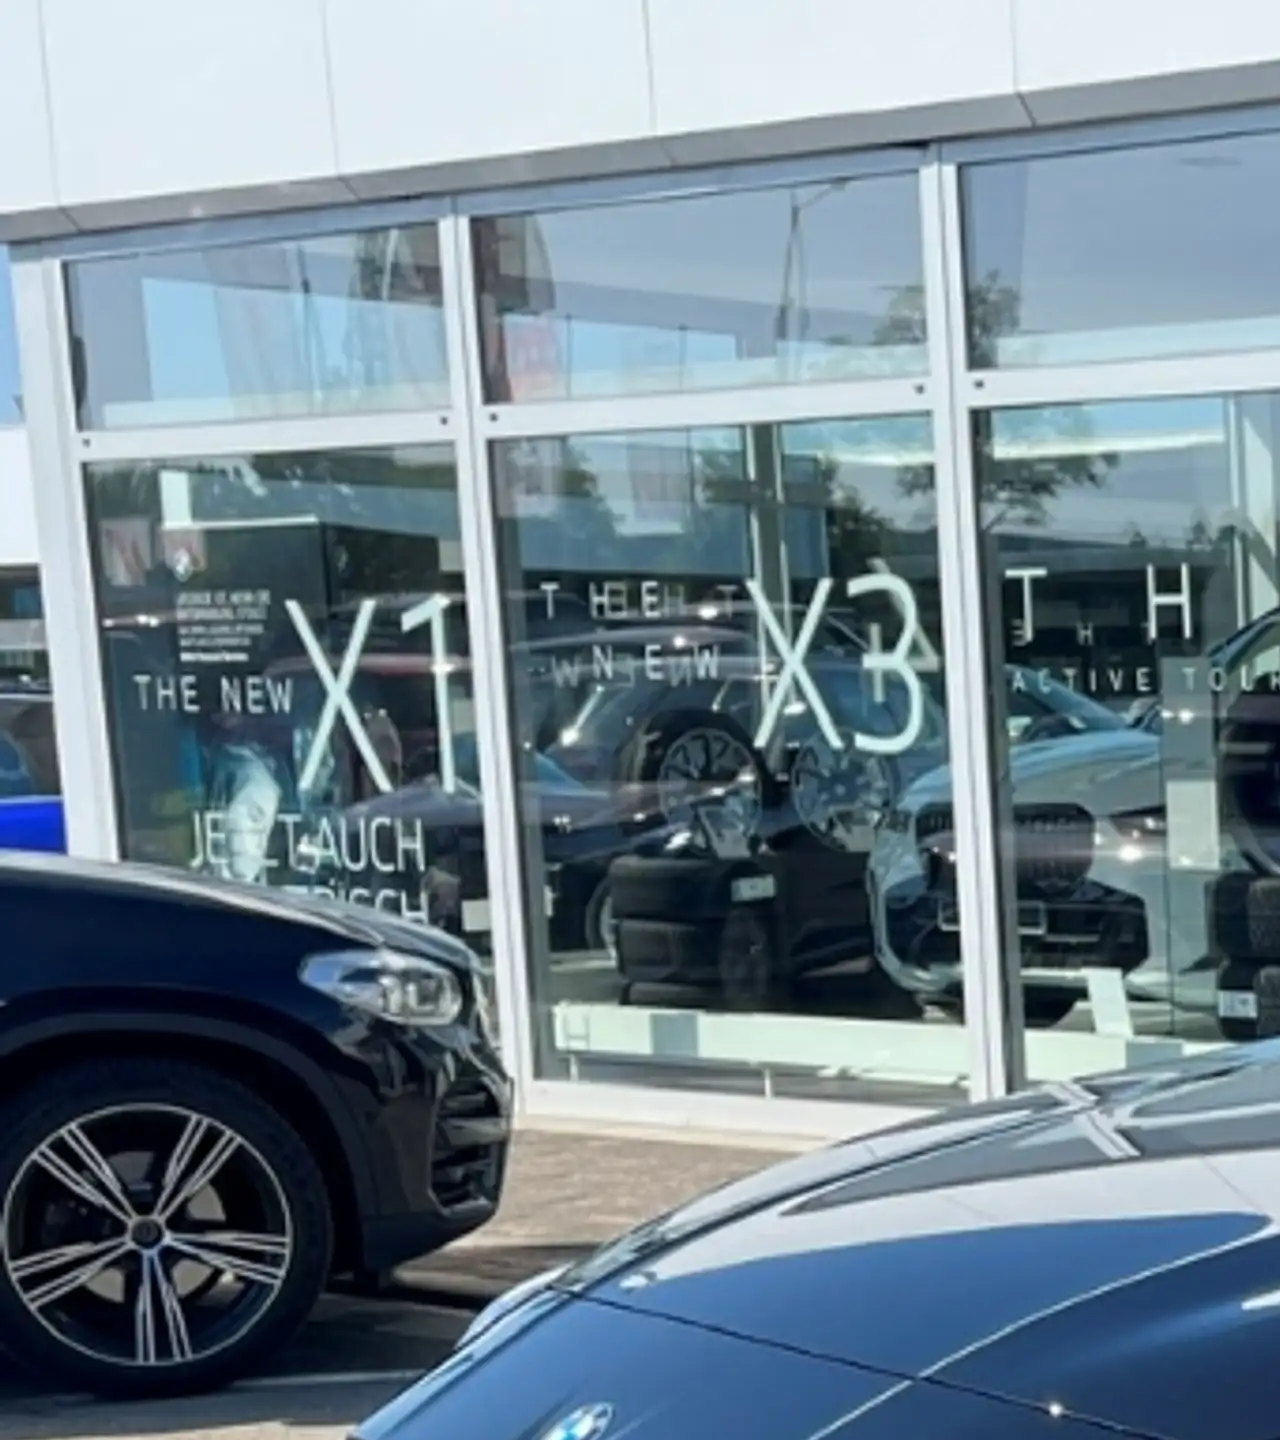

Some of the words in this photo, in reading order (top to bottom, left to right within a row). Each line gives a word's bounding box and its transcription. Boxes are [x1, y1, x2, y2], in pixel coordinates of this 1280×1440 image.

[132, 674, 201, 714] THE
[219, 676, 294, 714] NEW
[284, 592, 460, 794] X1
[744, 572, 924, 756] X3
[1011, 667, 1153, 693] ACTIVE
[315, 816, 426, 873] AUCH
